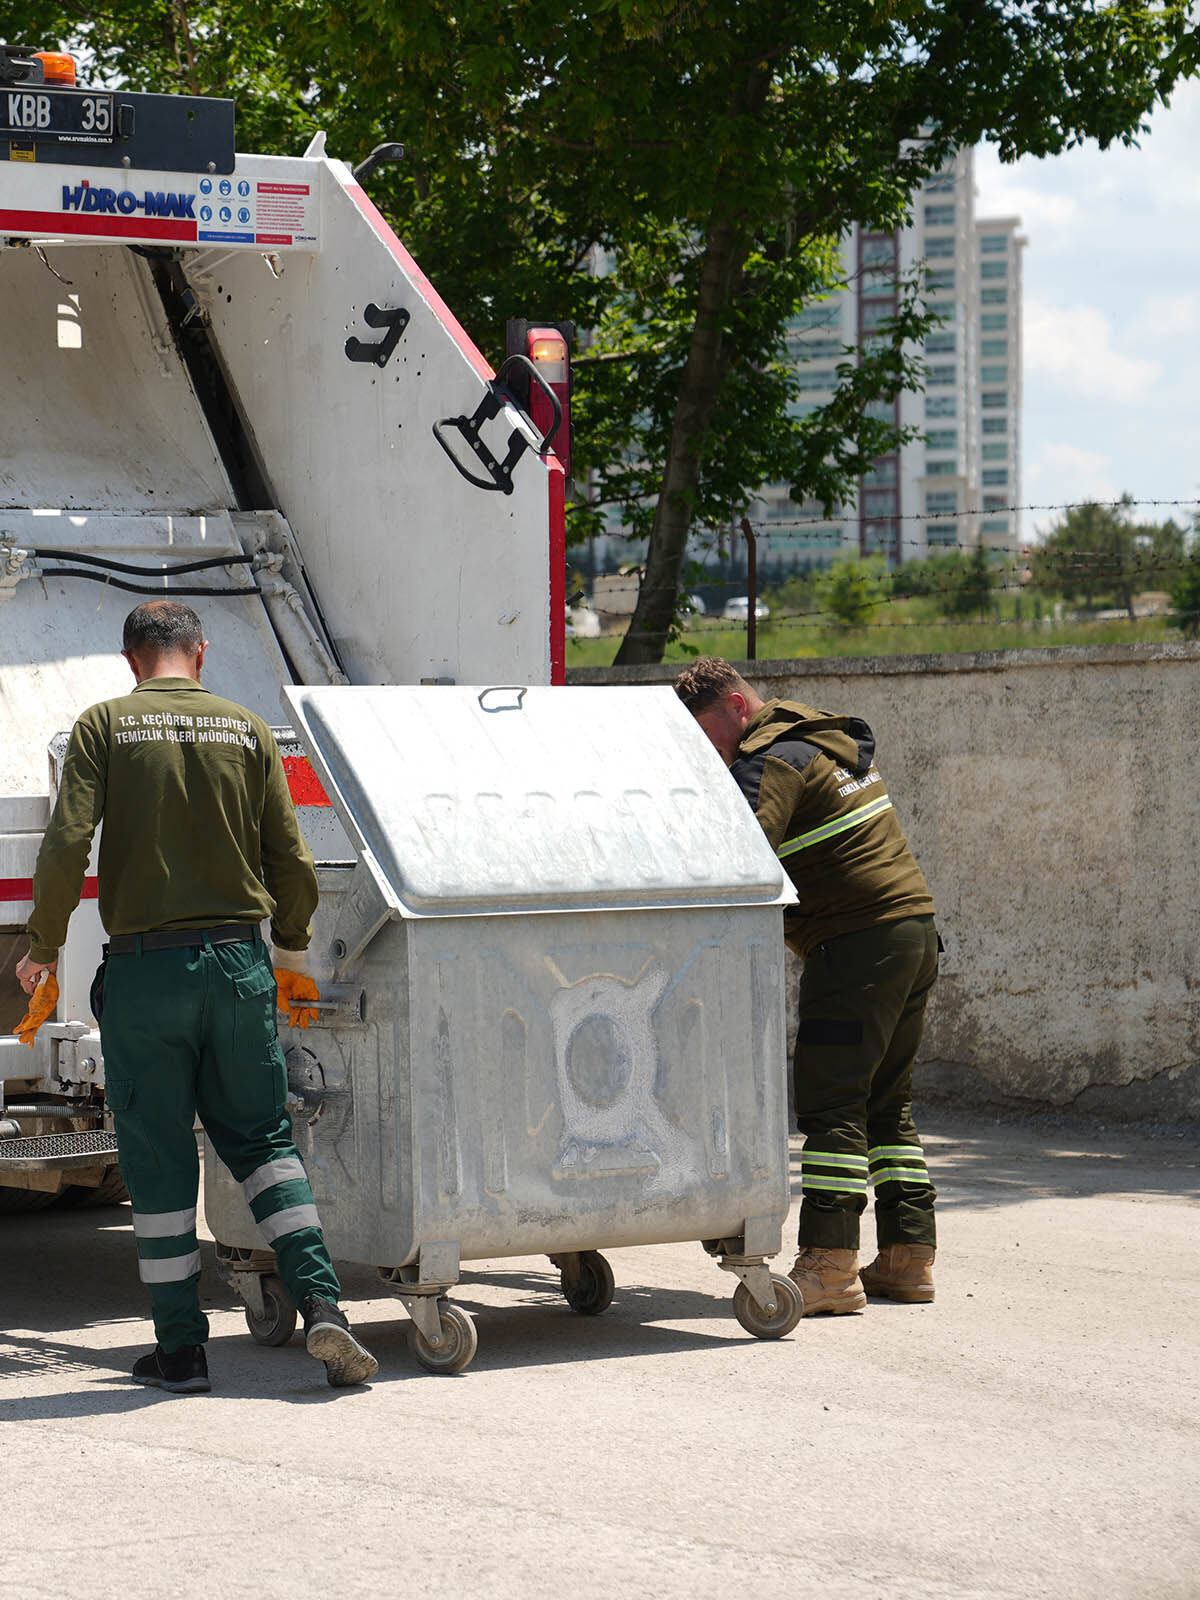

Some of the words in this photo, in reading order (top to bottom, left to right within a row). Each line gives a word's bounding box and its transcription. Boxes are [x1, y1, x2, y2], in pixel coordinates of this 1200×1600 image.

[8, 93, 51, 128] KBB
[81, 98, 110, 131] 35
[62, 180, 196, 219] HİDRO-MAK
[119, 716, 140, 727] T.C.
[141, 712, 193, 728] KEÇİÖREN
[196, 716, 251, 733] BELEDİYESİ
[115, 727, 164, 745] TEMİZLİK
[166, 729, 196, 745] İŞLERİ
[198, 730, 257, 750] MÜDÜRLÜĞÜ
